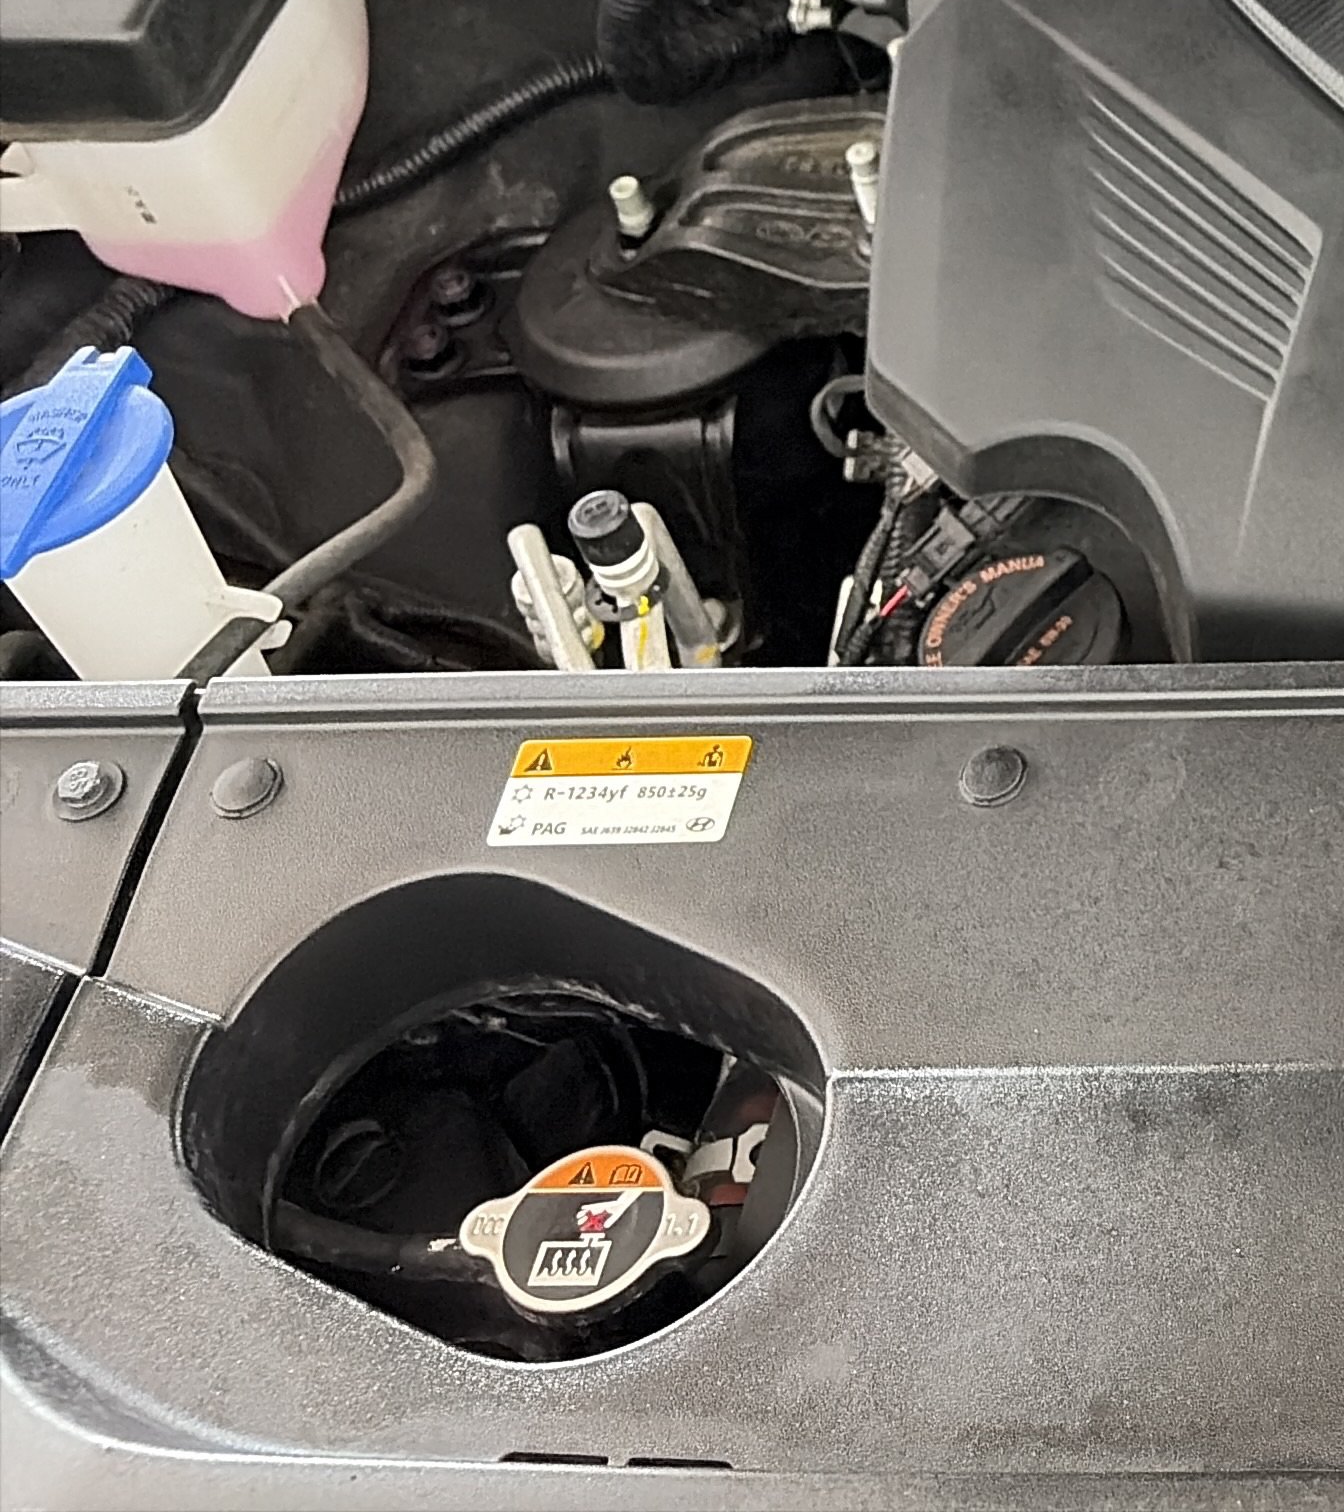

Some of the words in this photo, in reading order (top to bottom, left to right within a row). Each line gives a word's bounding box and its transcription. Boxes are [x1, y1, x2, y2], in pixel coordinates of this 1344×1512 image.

[979, 555, 1045, 584] MANUA
[544, 784, 629, 803] R-1234yf
[637, 785, 707, 801] 850±25g
[531, 822, 567, 836] PAG
